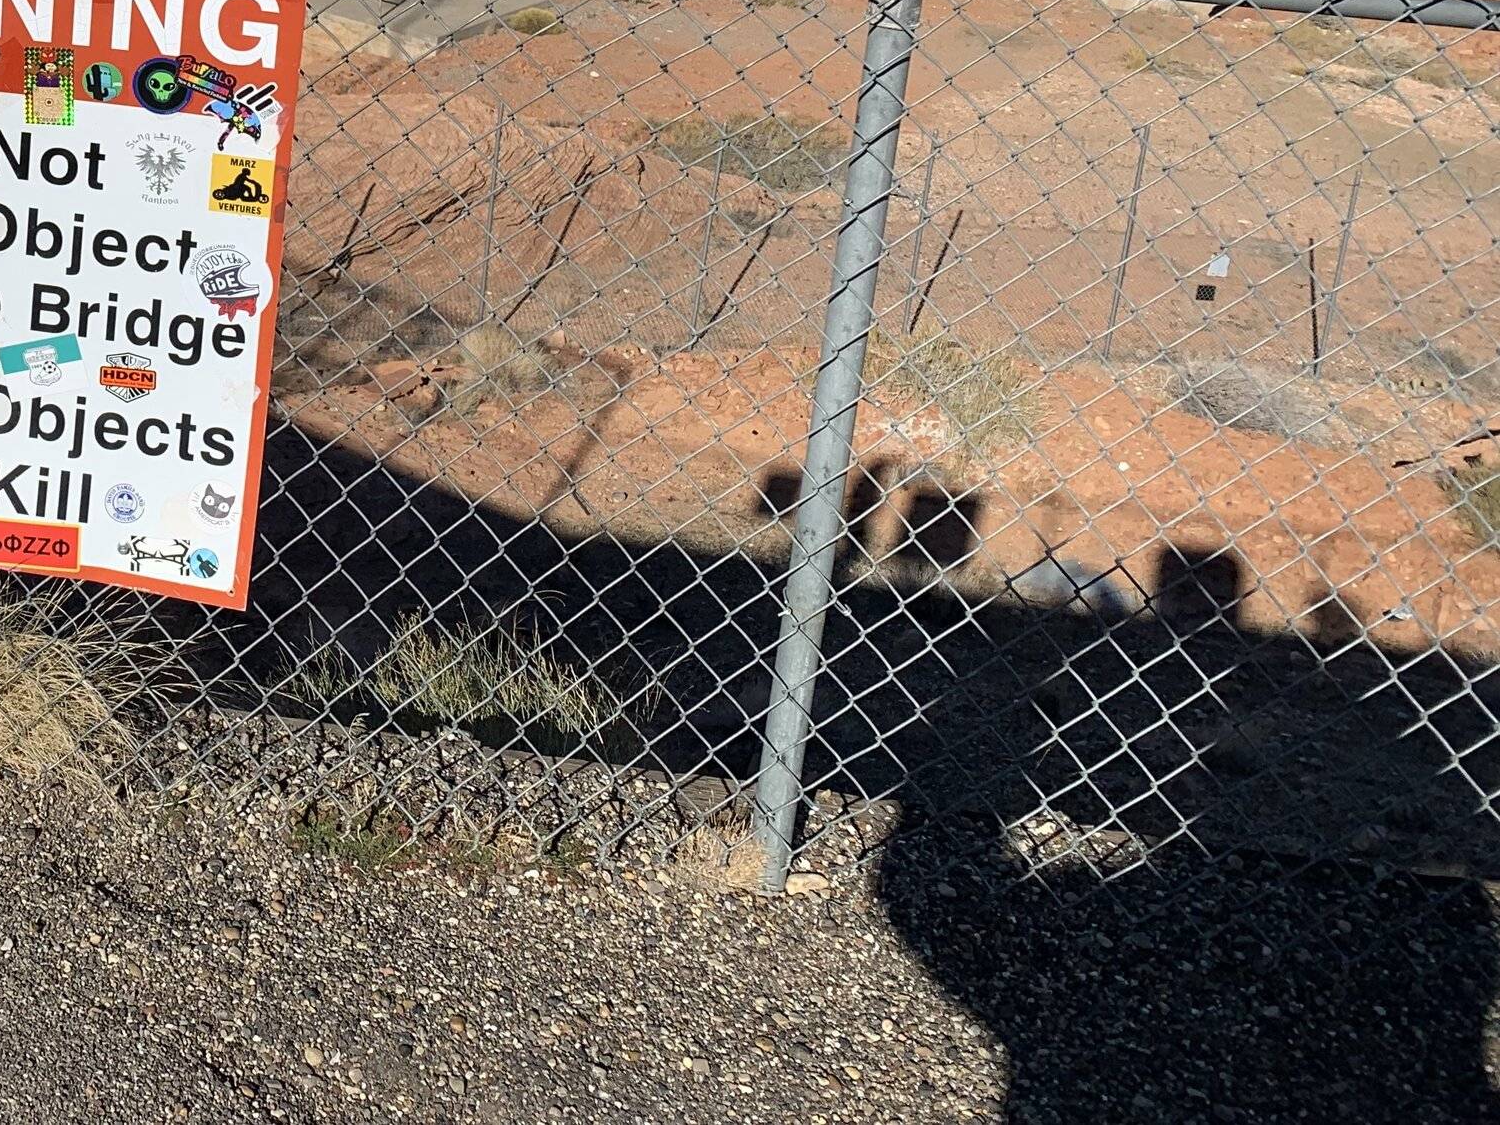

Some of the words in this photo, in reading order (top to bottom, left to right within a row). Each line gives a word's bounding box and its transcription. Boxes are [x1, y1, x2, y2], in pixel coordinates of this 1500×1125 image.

[230, 158, 257, 169] MARZ
[219, 202, 262, 215] VENTURES
[30, 283, 246, 366] Bridge
[103, 369, 154, 382] HDCN
